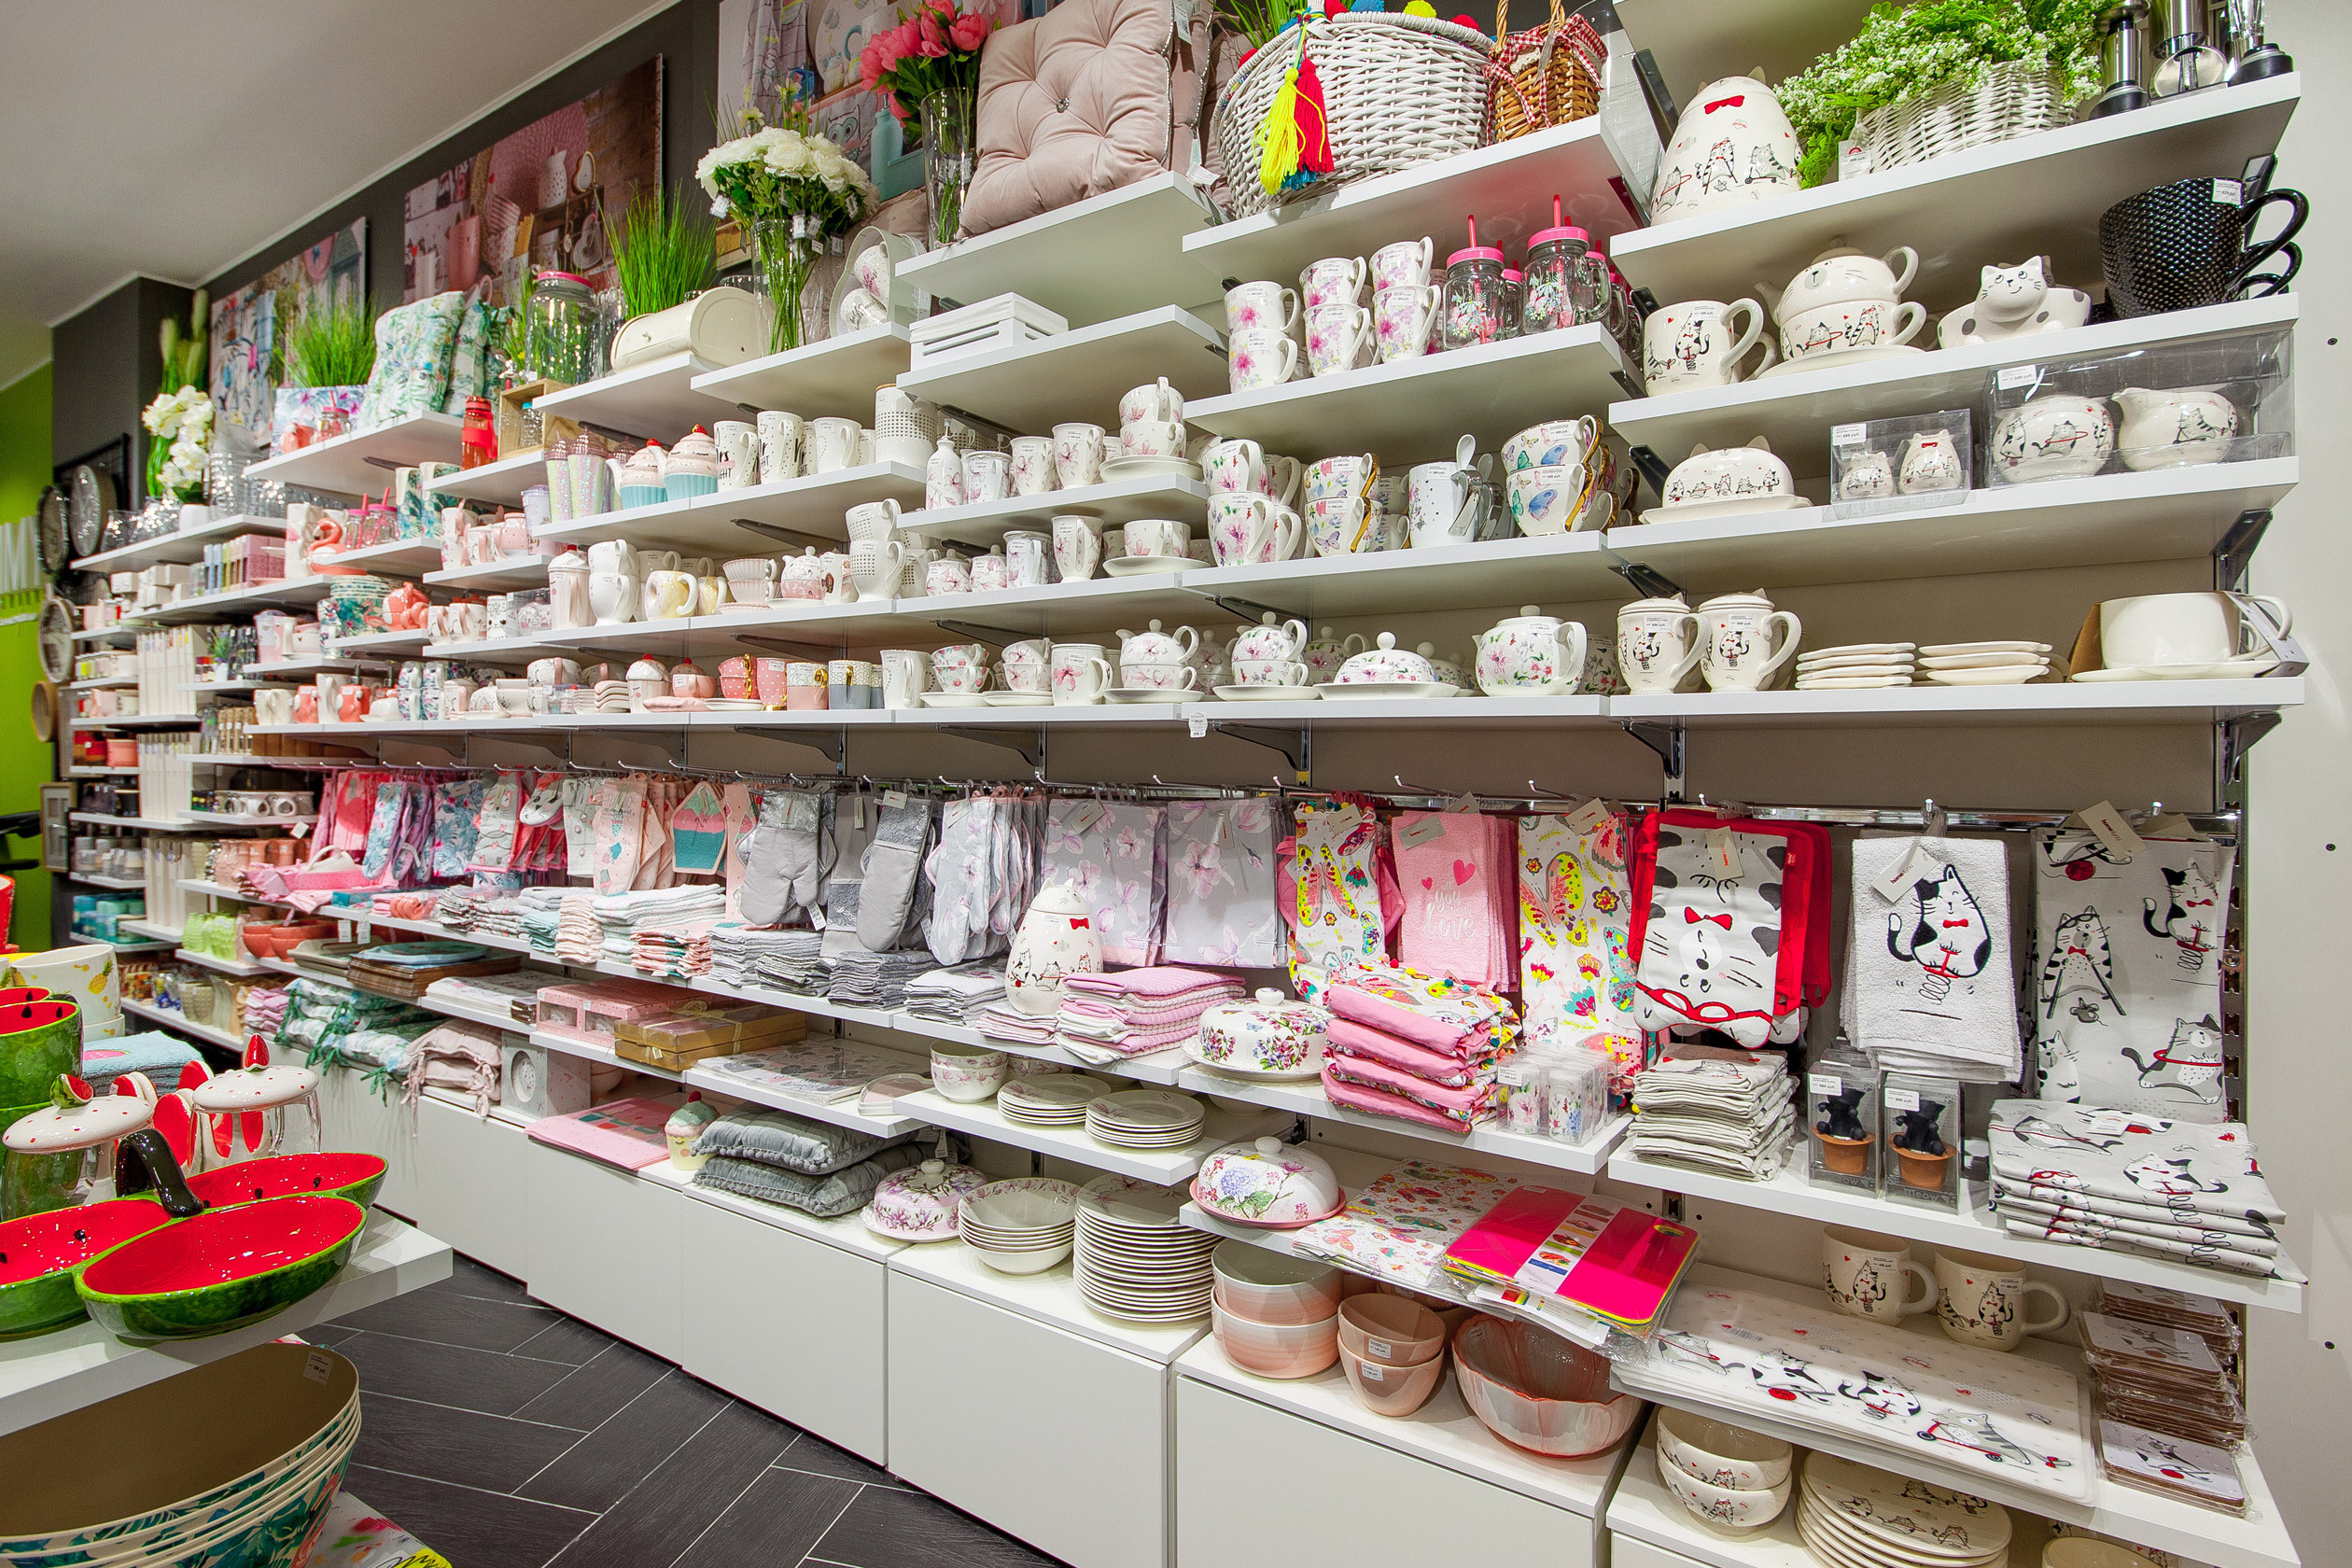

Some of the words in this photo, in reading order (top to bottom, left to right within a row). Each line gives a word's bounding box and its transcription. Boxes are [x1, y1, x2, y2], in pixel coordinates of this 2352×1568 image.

[1890, 864, 1914, 885] home&you
[1435, 890, 1462, 913] you
[1423, 903, 1477, 941] love
[1904, 1187, 1939, 1201] meow
